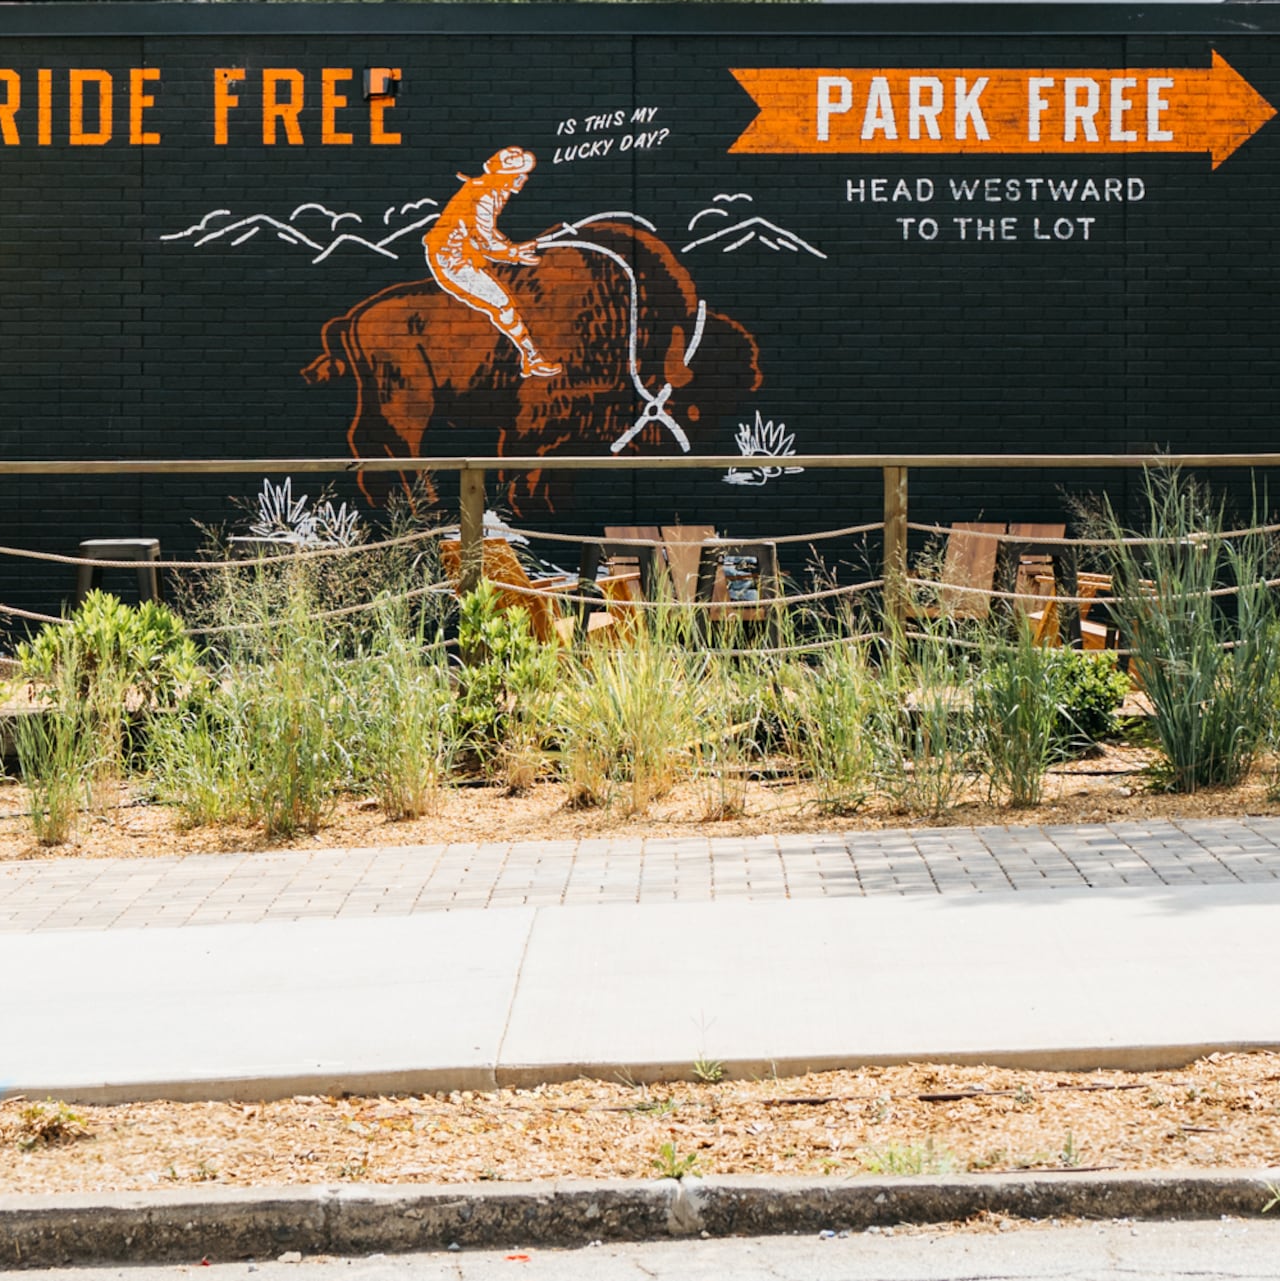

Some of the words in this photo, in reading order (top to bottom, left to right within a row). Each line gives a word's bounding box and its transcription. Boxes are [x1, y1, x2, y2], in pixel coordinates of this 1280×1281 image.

[214, 68, 401, 145] FREE
[557, 118, 577, 136] IS
[584, 110, 625, 132] THIS
[630, 106, 658, 123] MY
[816, 76, 991, 141] PARK
[1027, 77, 1174, 142] FREE
[552, 138, 614, 164] LUCKY
[619, 127, 670, 152] DAY?
[846, 178, 934, 202] HEAD
[949, 178, 1146, 202] WESTWARD
[896, 217, 939, 240] TO
[953, 217, 1018, 240] THE
[1033, 217, 1096, 240] LOT
